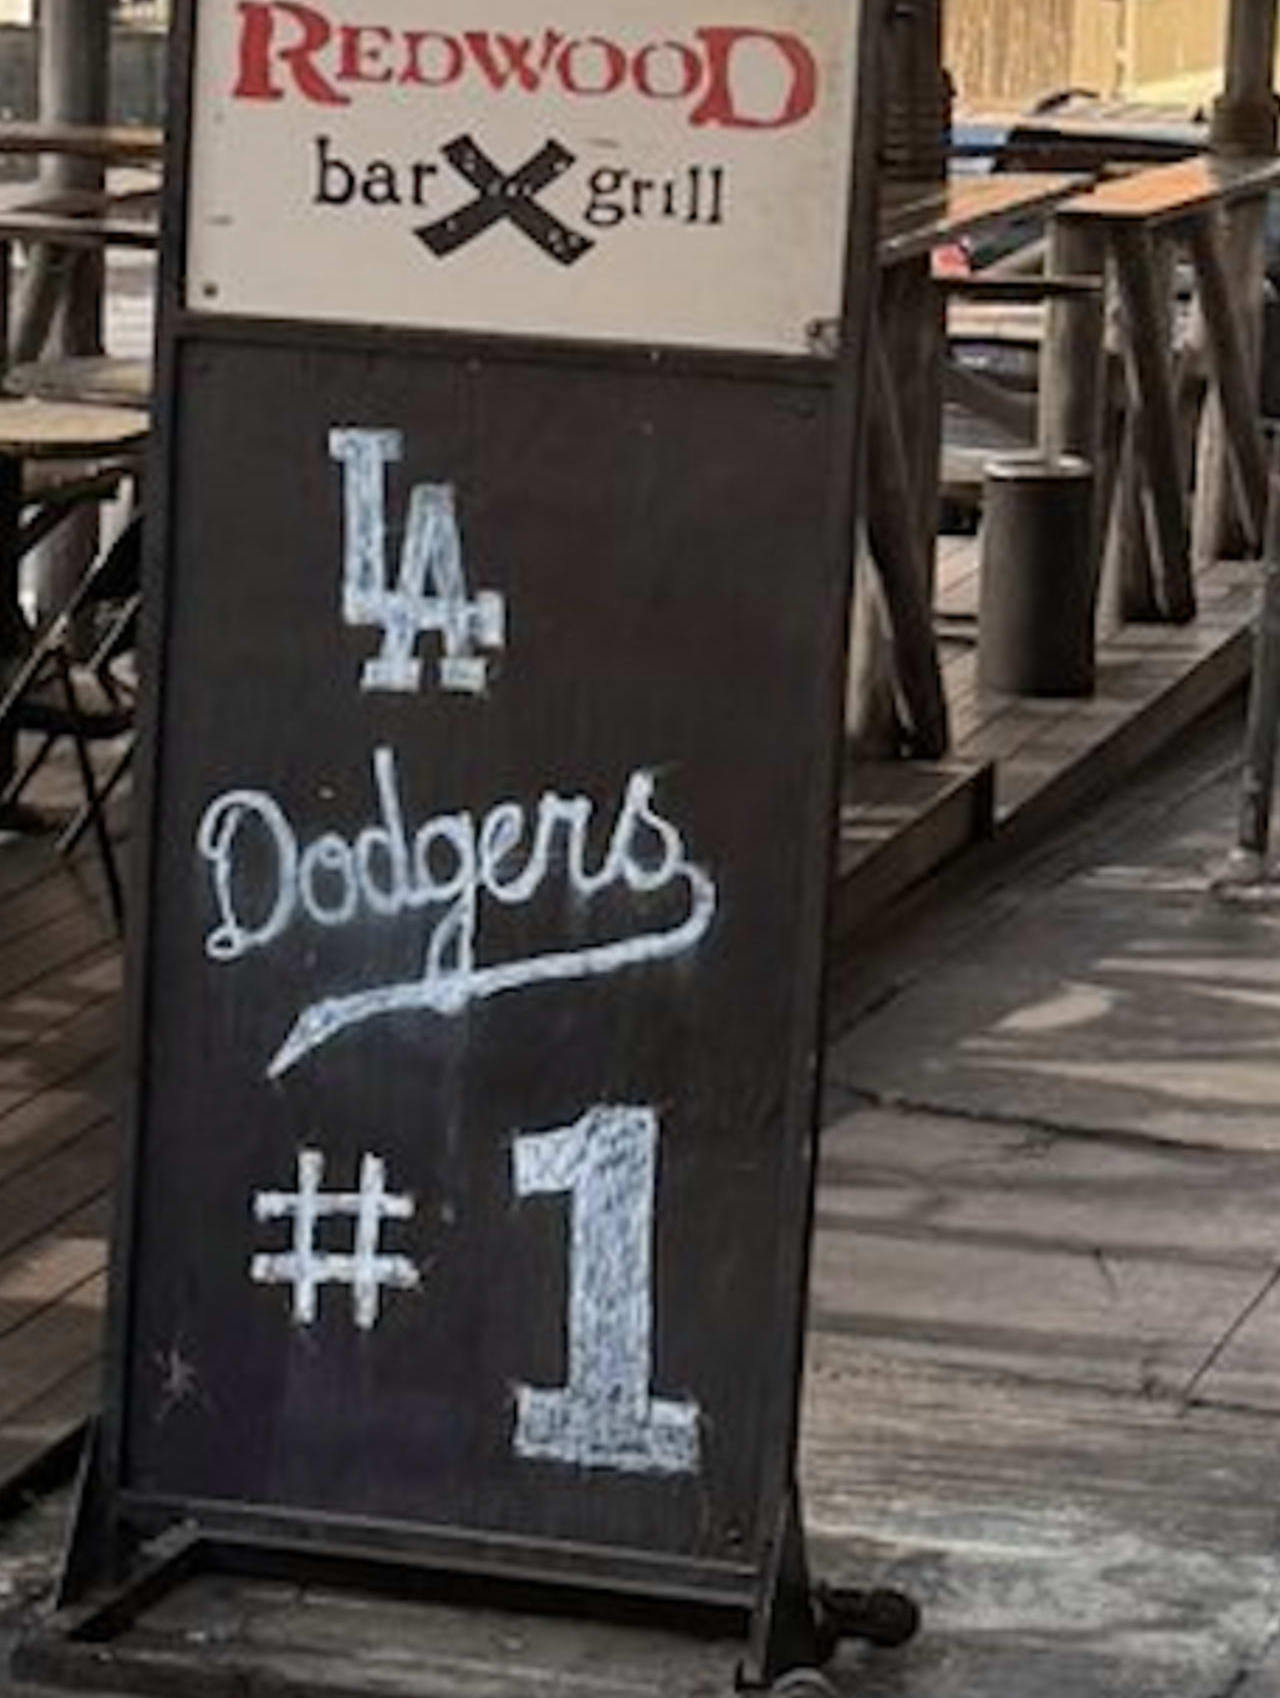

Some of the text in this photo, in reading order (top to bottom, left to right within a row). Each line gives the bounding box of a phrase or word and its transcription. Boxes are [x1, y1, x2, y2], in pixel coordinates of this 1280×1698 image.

[233, 0, 818, 130] REDWOOD
[314, 137, 726, 227] bar grill
[328, 427, 506, 693] LA
[197, 747, 717, 1078] Dodgers
